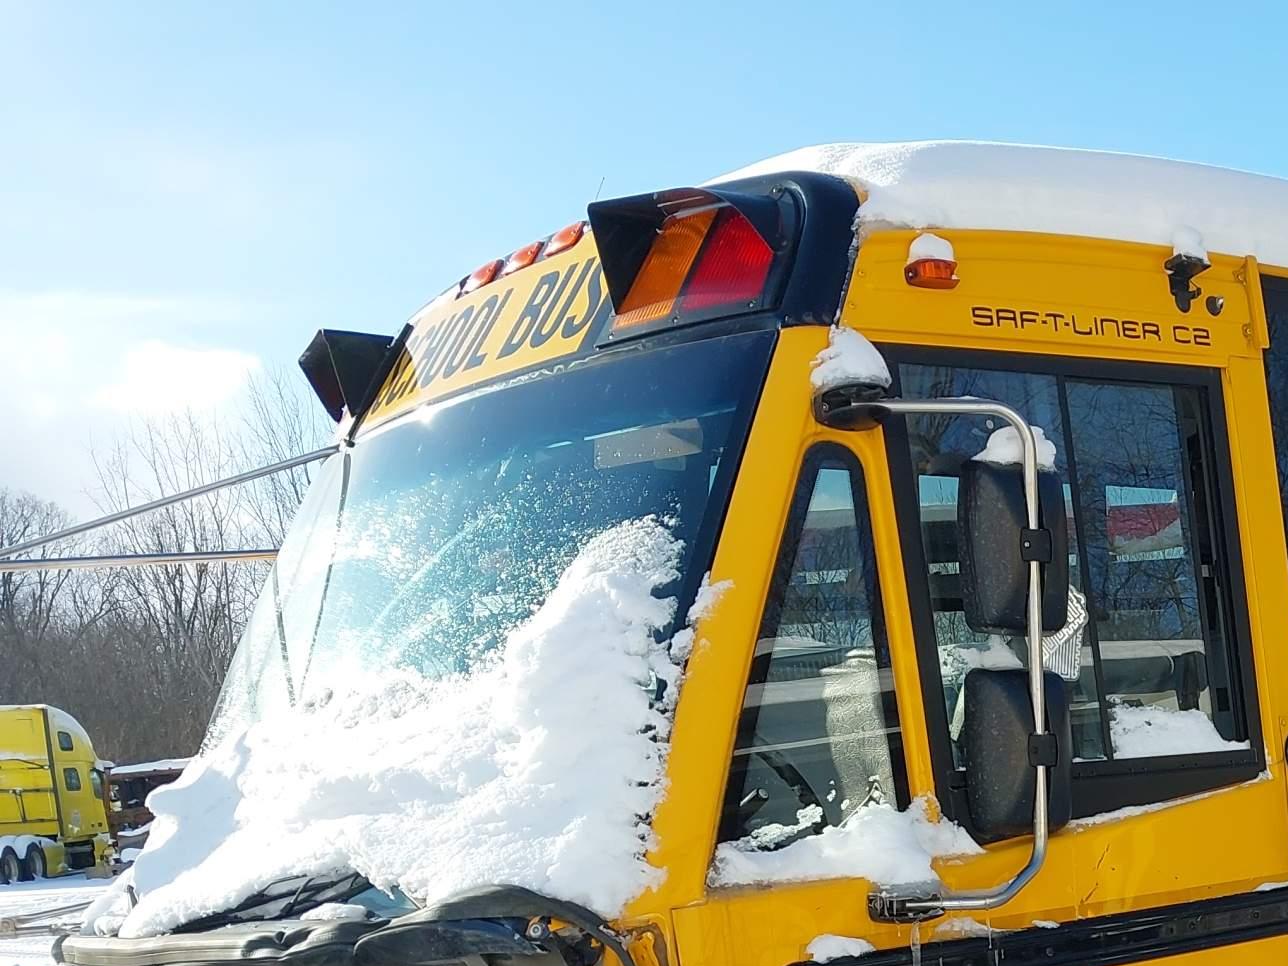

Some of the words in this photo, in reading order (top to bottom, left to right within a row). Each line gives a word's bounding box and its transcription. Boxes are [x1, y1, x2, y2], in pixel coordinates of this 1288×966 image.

[496, 256, 603, 360] BUS
[971, 306, 1161, 342] SAF-T-LINER
[1172, 325, 1211, 347] C2
